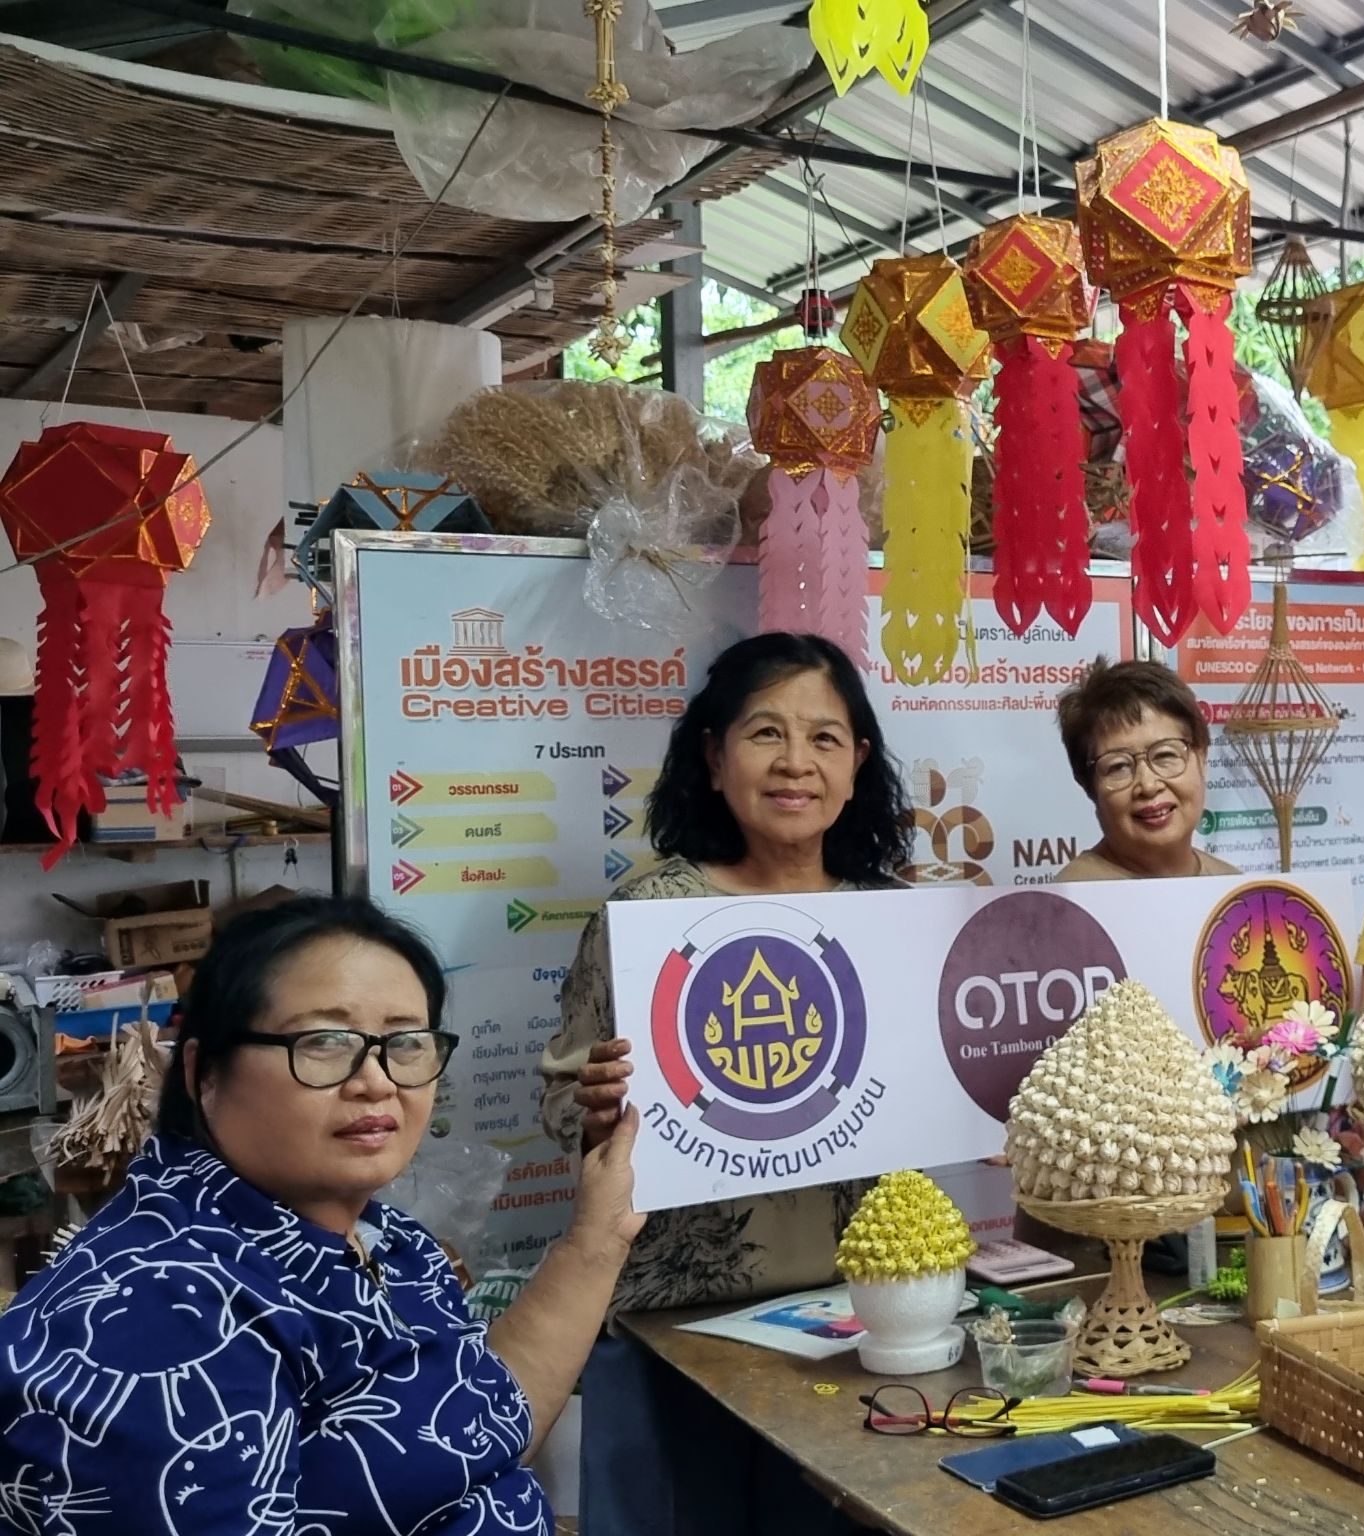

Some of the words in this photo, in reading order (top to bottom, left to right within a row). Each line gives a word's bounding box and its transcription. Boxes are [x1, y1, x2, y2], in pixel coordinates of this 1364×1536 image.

[400, 645, 687, 688] เมืองสร้างสรรค์
[401, 693, 569, 718] Creative
[584, 694, 687, 717] Cities
[534, 744, 544, 759] 7
[549, 742, 606, 760] ประเภท
[448, 782, 519, 796] วรรณกรรม
[464, 822, 503, 839] ดนตรี
[1013, 837, 1077, 868] NAN
[460, 866, 507, 884] สื่อศิลปะ
[954, 966, 1117, 1030] OTOP
[472, 1019, 501, 1038] ภูเก็ต
[959, 1044, 988, 1059] One
[990, 1038, 1043, 1056] Tambon
[643, 1076, 887, 1179] กรมการพัฒนาชุมชน
